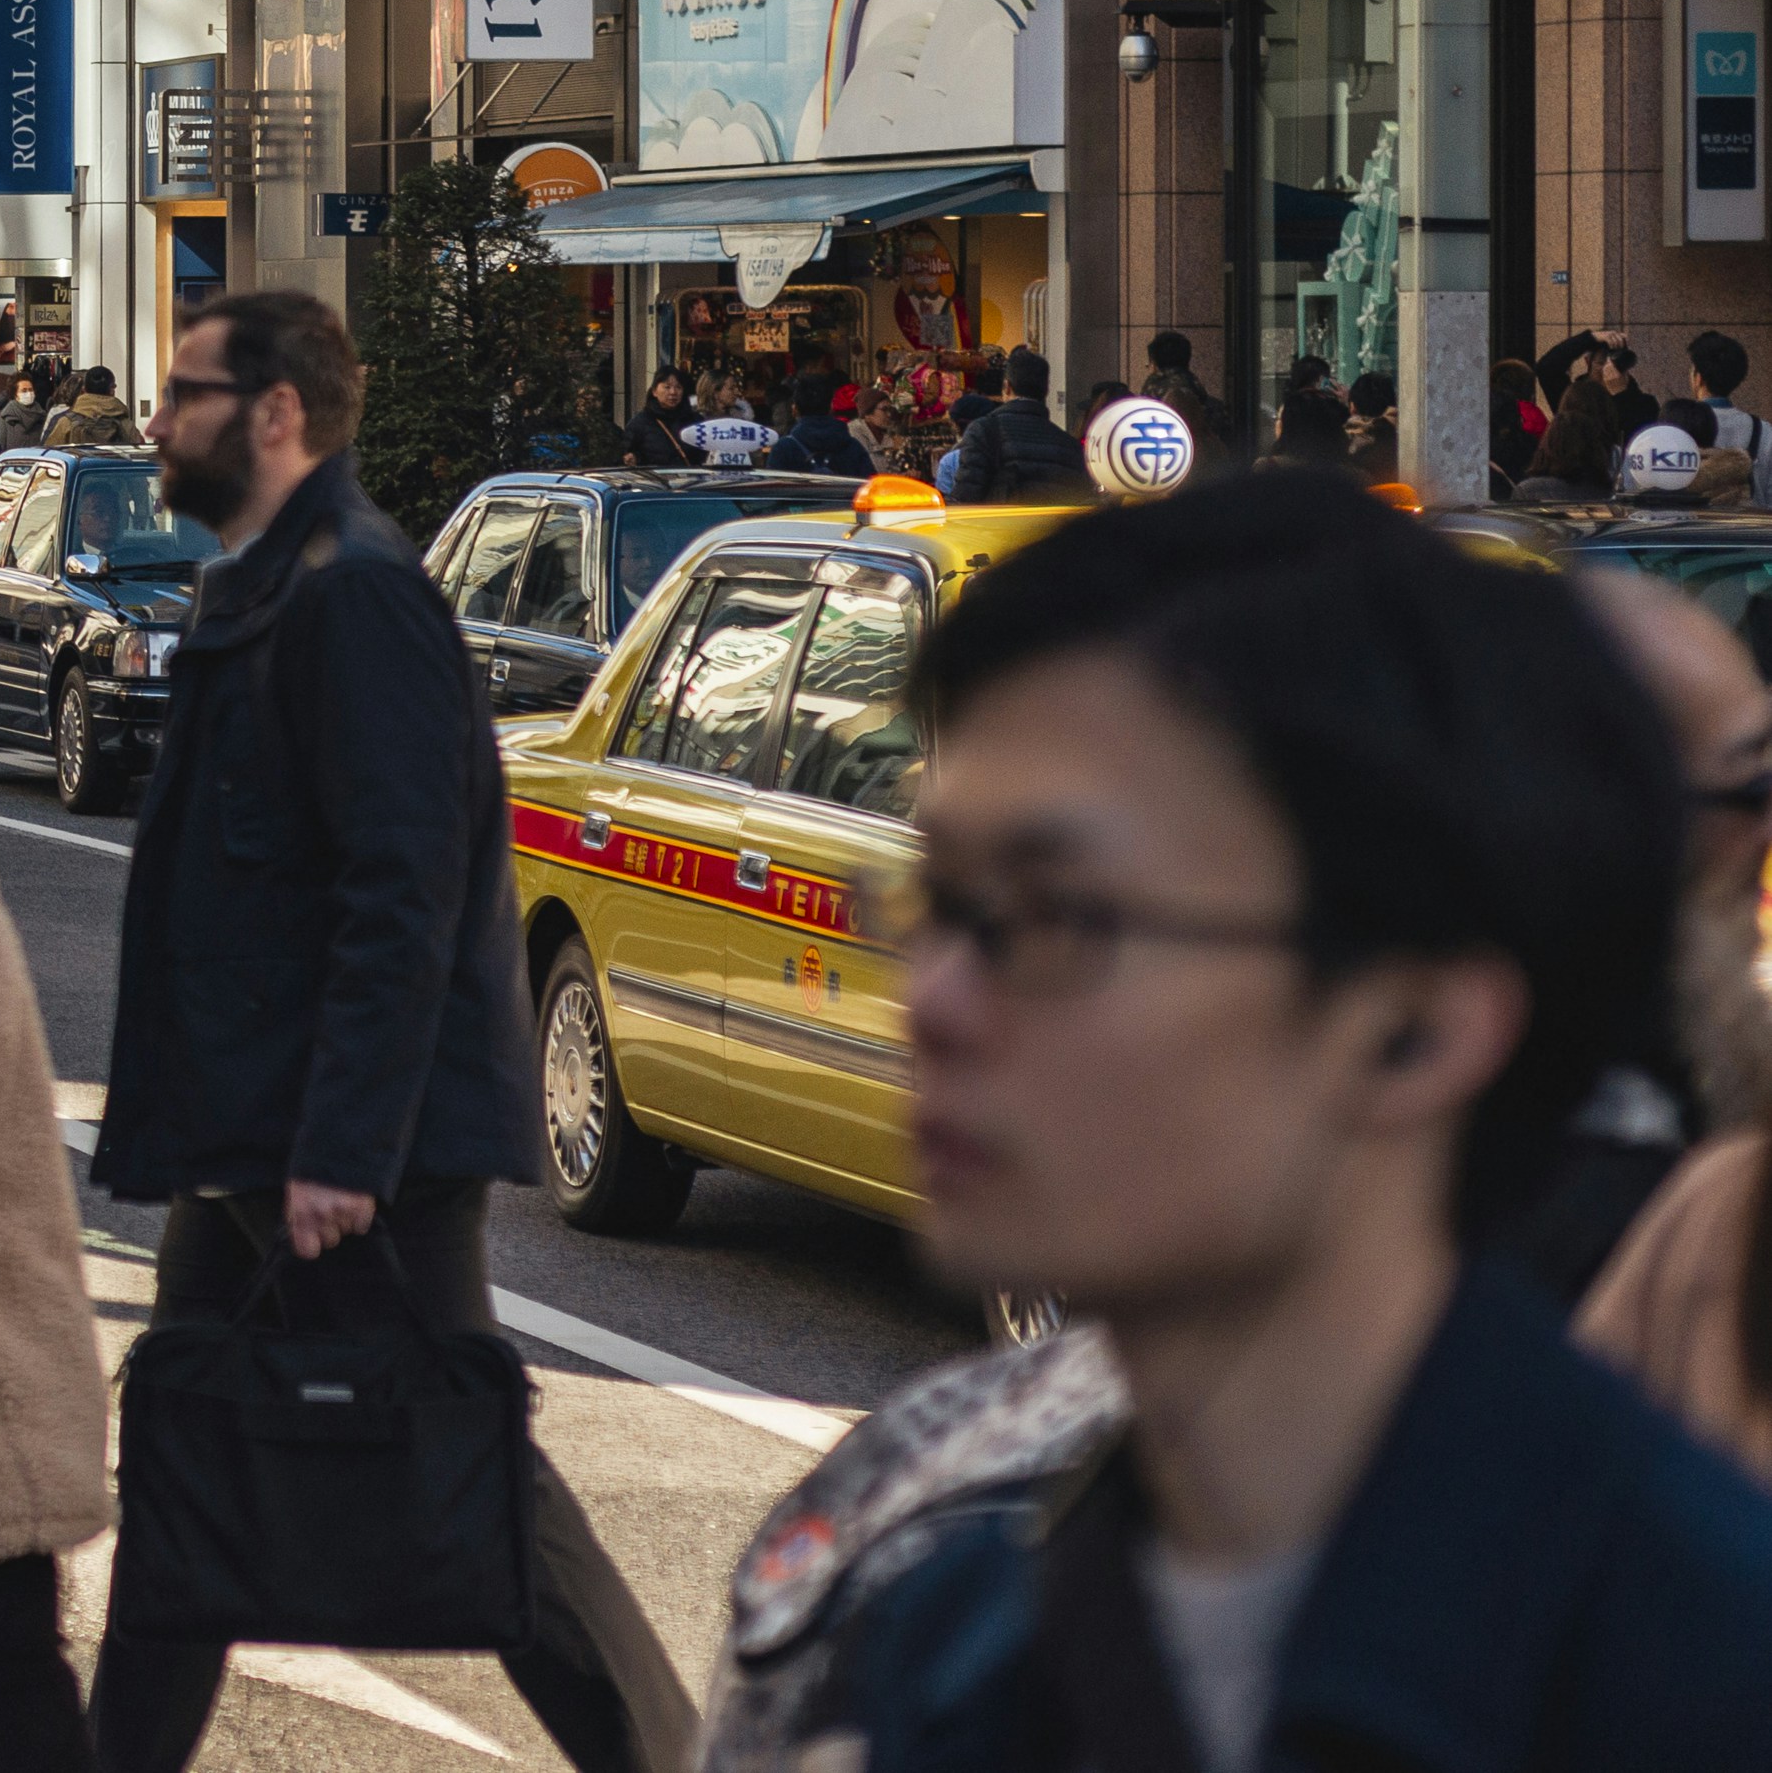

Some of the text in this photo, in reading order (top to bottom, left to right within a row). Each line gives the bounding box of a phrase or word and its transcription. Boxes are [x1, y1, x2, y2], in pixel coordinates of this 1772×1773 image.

[12, 60, 37, 172] ROYAL
[1700, 132, 1754, 146] 東京メトロ
[533, 185, 575, 197] GINZA
[719, 452, 746, 465] 1347
